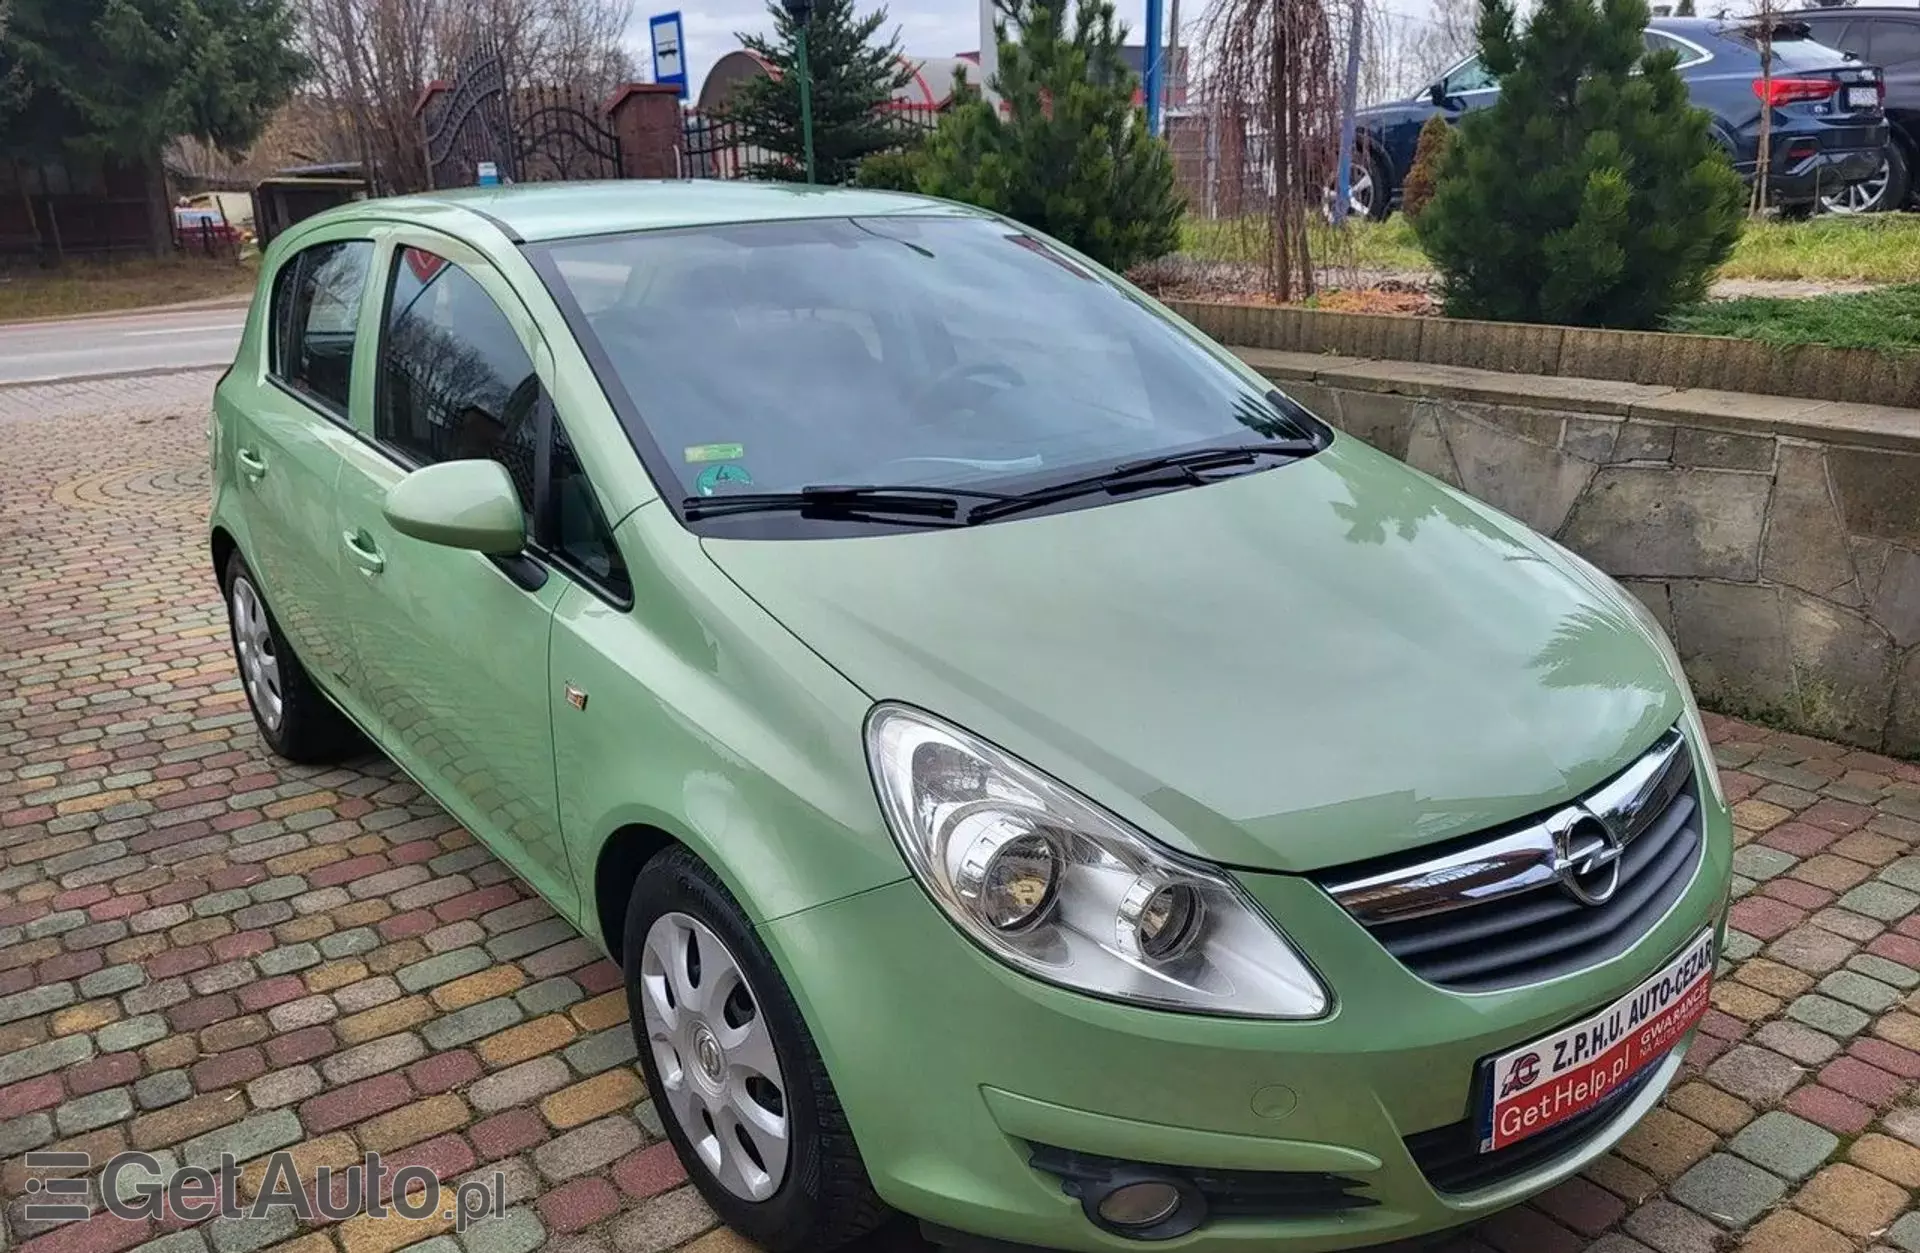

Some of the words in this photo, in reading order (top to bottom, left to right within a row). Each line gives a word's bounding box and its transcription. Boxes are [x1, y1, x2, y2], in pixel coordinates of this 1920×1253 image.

[1553, 1011, 1624, 1072] Z.P.H.U.
[1628, 939, 1712, 1028] AUTO-CEZAR
[1501, 1044, 1630, 1136] GetHelp.pl
